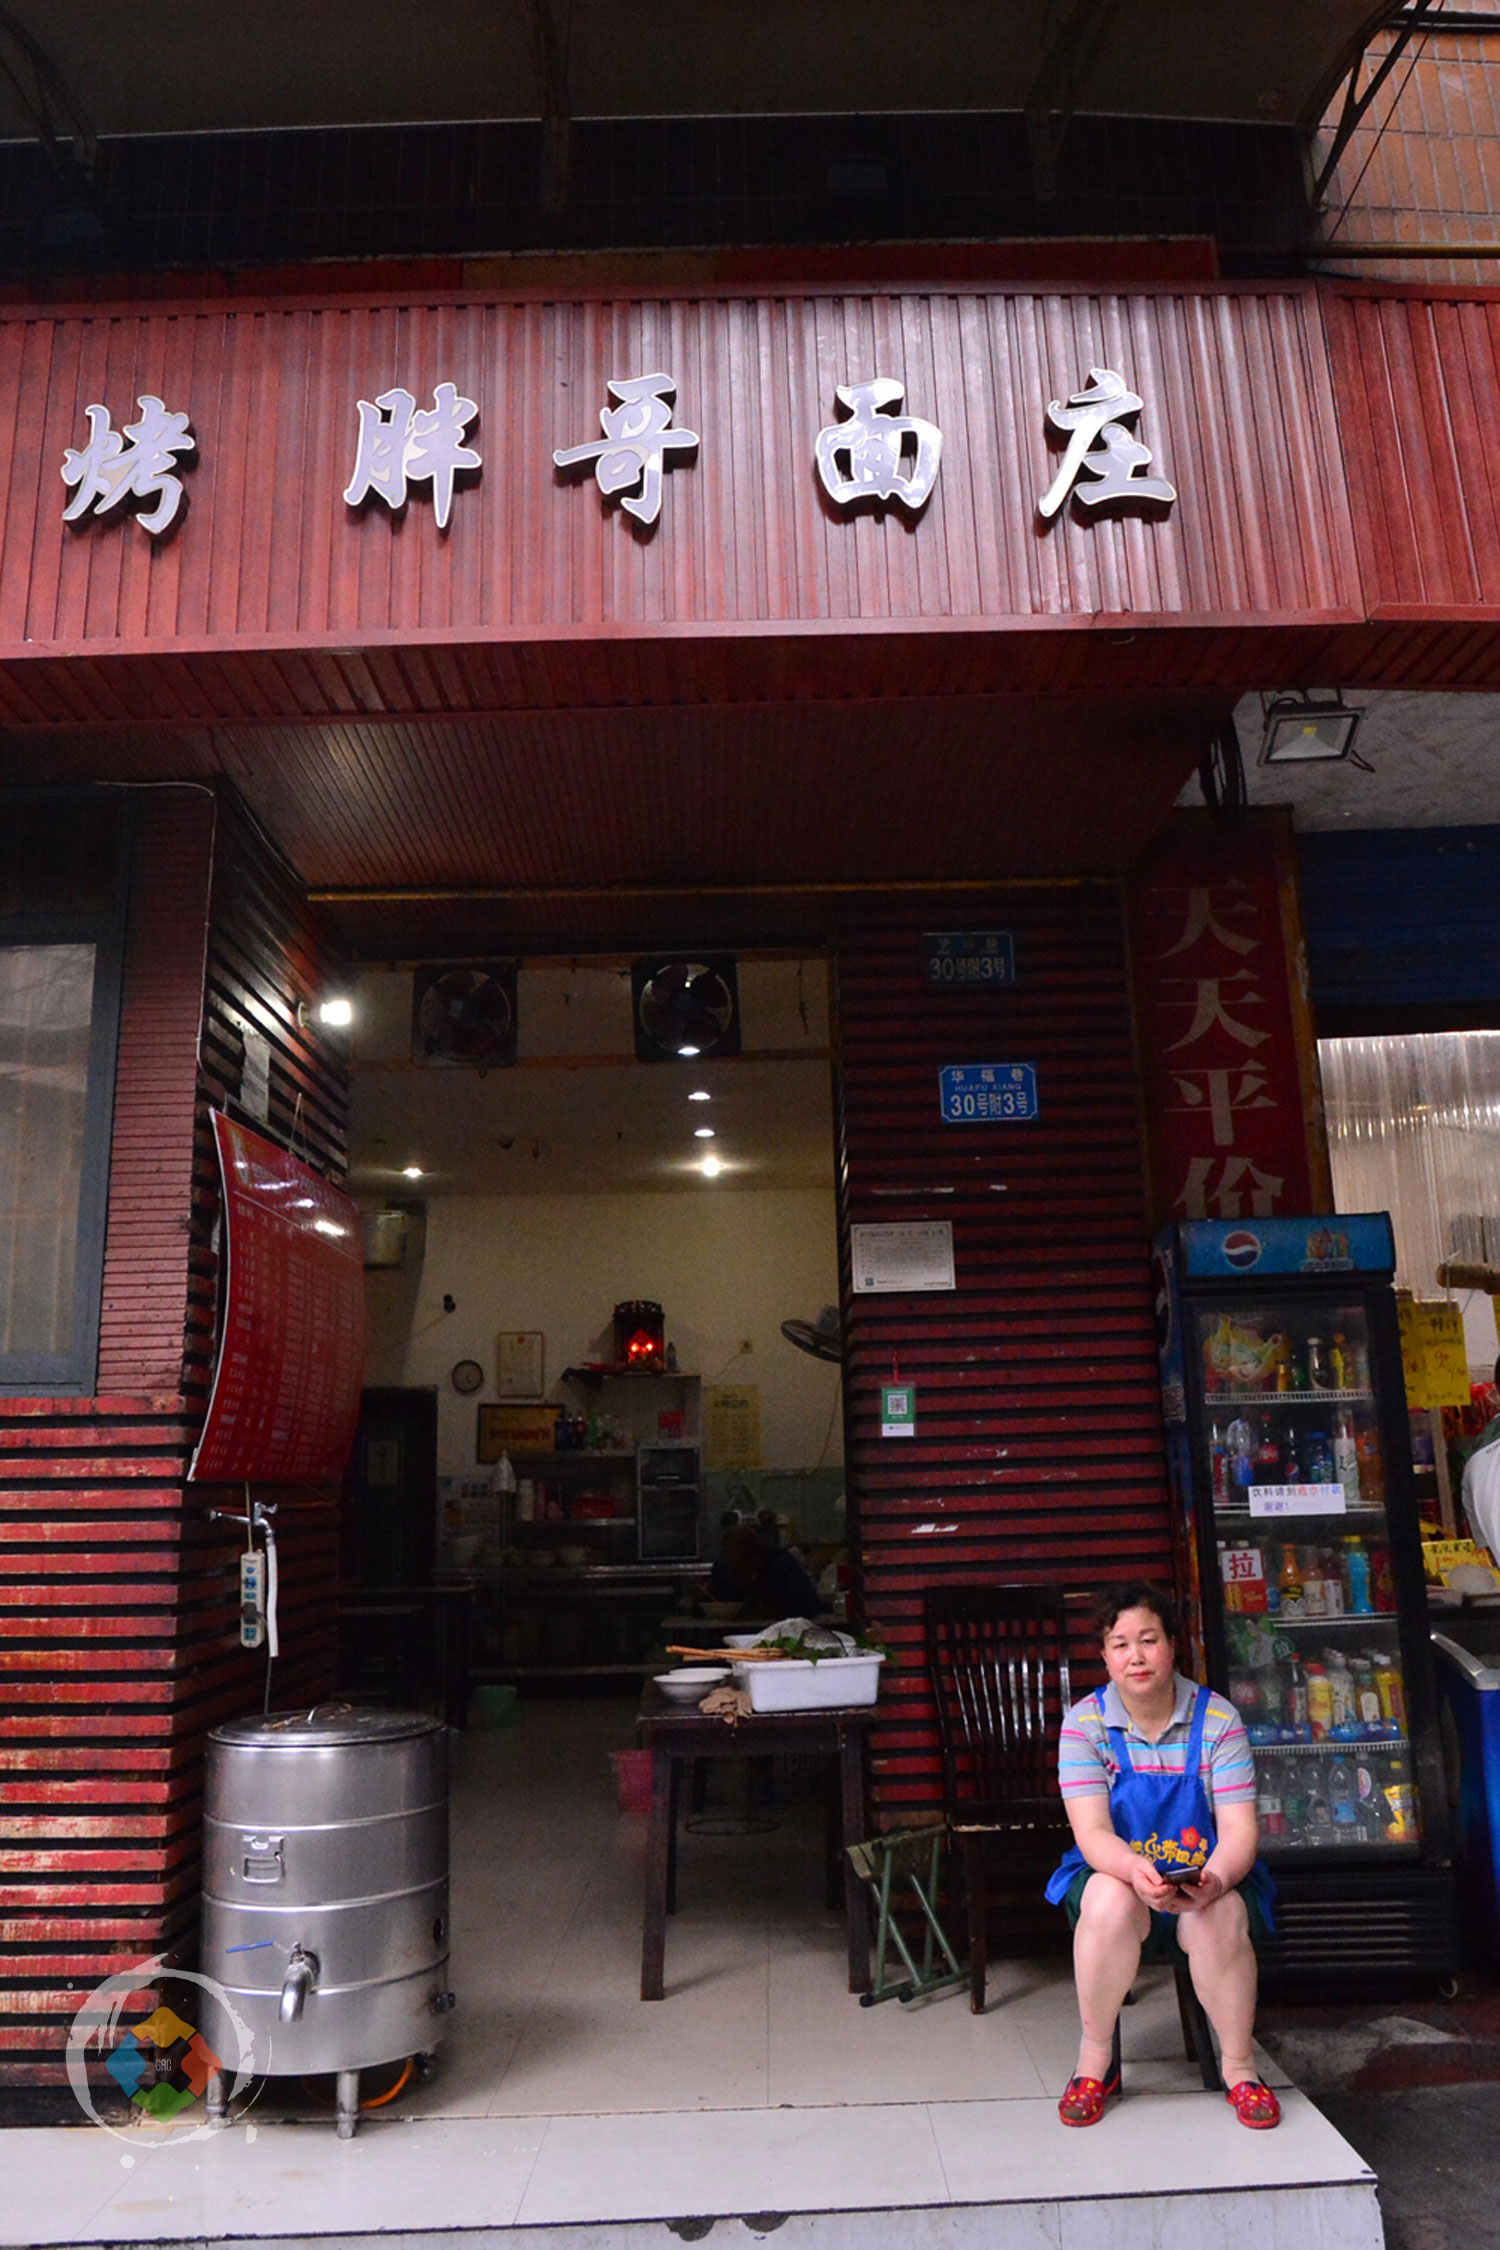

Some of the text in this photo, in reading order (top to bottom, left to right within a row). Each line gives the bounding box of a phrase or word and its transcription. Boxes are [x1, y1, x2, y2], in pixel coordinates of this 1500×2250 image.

[61, 367, 1178, 535] 烤胖哥面庄
[929, 956, 1006, 981] 30号附3号
[1147, 877, 1286, 1218] 天天平价
[951, 1067, 1025, 1084] 华福巷
[955, 1083, 1022, 1092] HUAFU XIANG
[950, 1091, 1028, 1117] 30号附3号
[1252, 1486, 1341, 1498] 饮料请到超市付款
[1228, 1552, 1256, 1579] 拉
[1276, 1640, 1291, 1657] 拉
